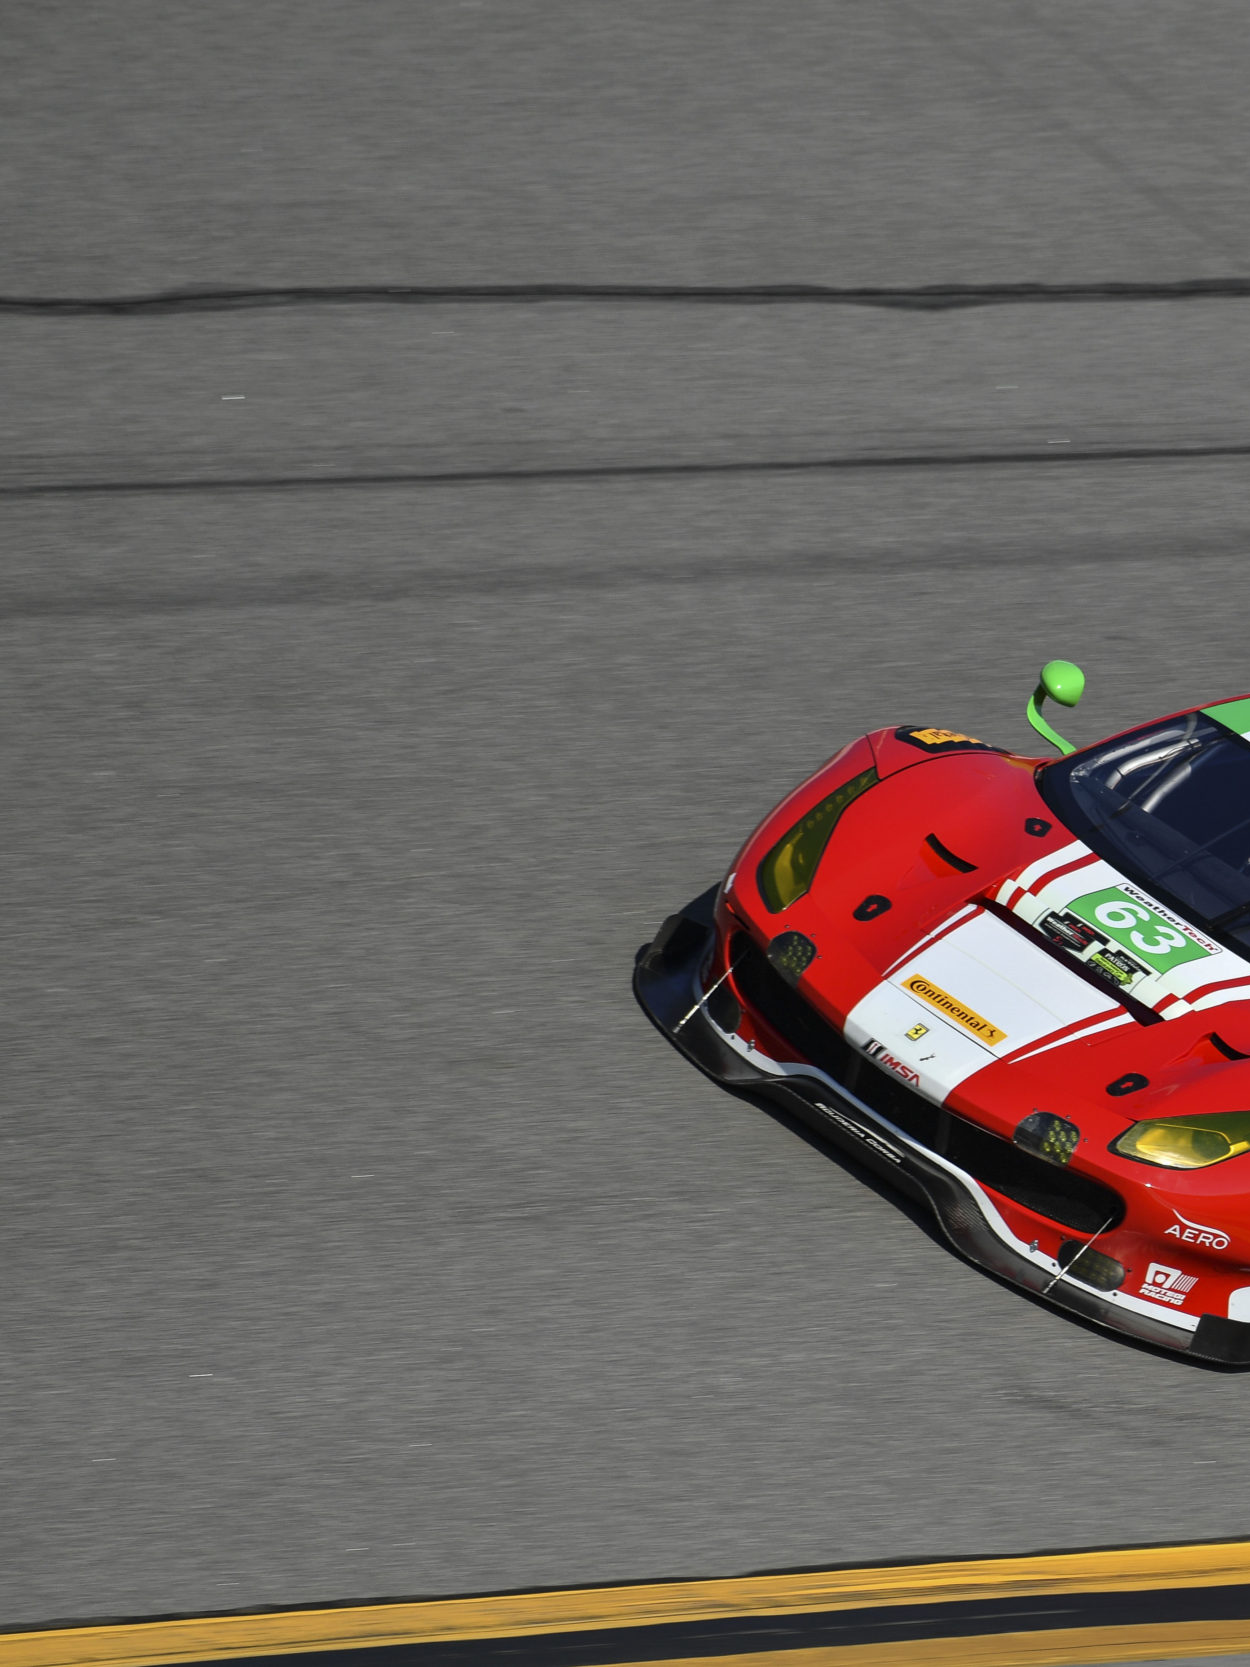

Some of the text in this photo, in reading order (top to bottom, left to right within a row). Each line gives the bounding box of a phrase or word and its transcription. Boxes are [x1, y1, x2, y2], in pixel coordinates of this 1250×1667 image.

[1094, 900, 1188, 955] 63
[1123, 886, 1218, 952] WeatherTech
[909, 979, 988, 1032] Continental
[879, 1053, 920, 1087] IMSA
[1164, 1224, 1230, 1250] AERO
[1139, 1288, 1184, 1306] RACING
[1142, 1283, 1187, 1300] MOTEGI
